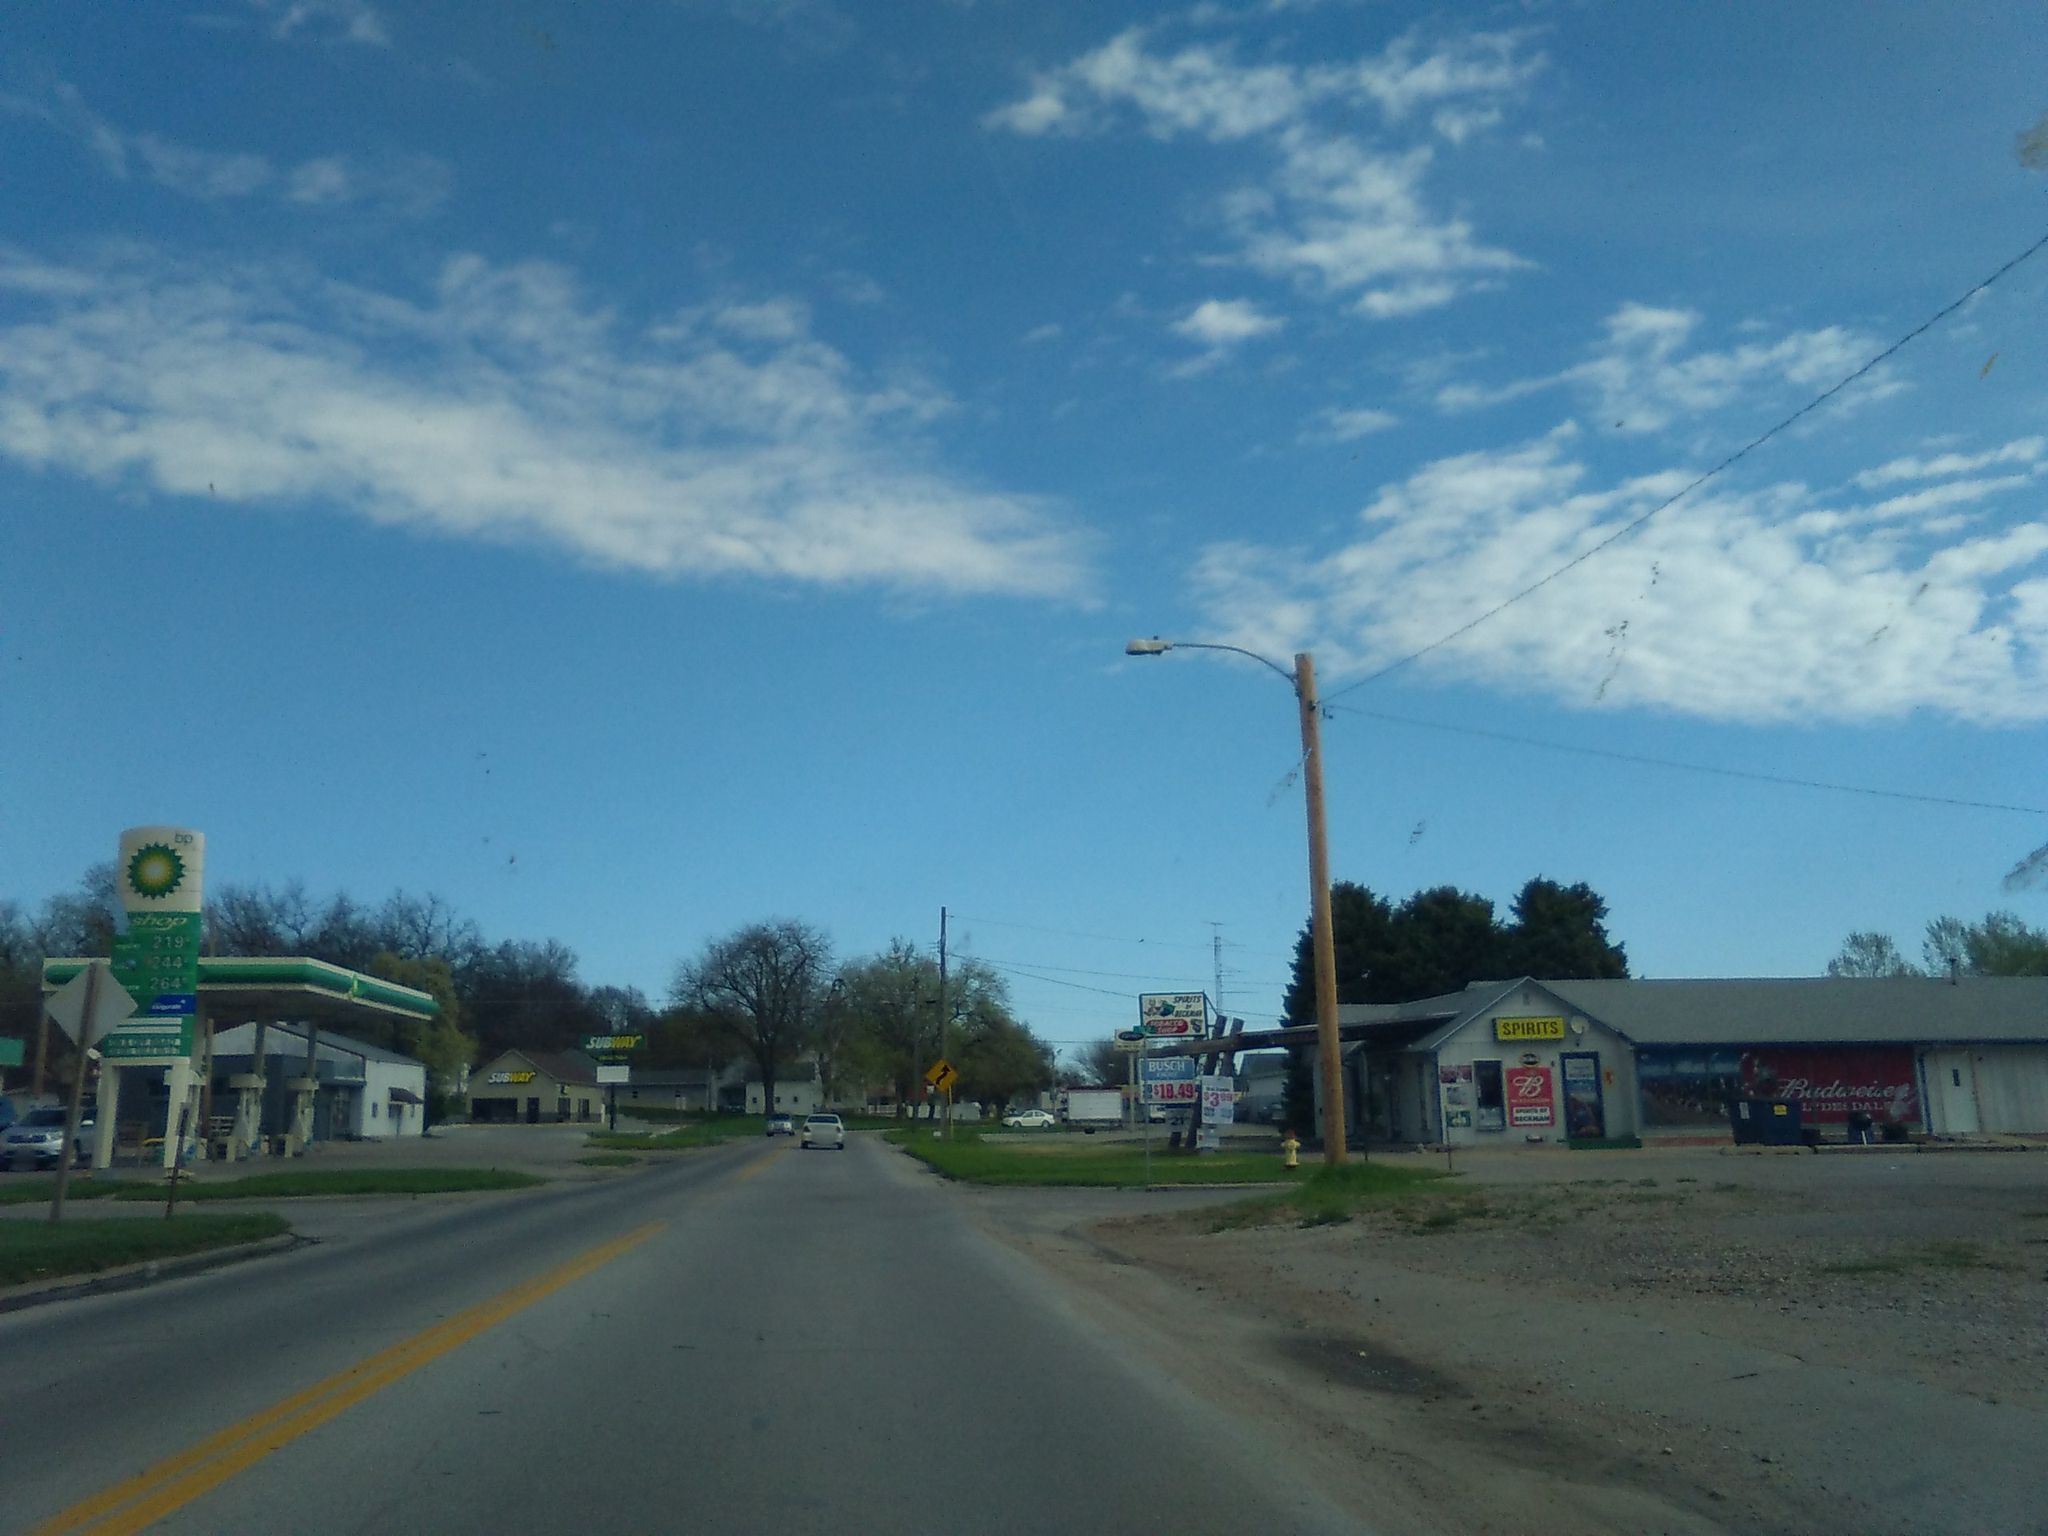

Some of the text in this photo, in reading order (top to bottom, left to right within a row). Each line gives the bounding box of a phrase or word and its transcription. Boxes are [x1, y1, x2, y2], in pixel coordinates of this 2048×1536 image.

[175, 832, 193, 846] bp
[1502, 1021, 1559, 1036] SPIRITS
[585, 1035, 643, 1049] SUBWAY
[1148, 1061, 1185, 1072] BUSCH
[488, 1072, 537, 1083] SUBWAY
